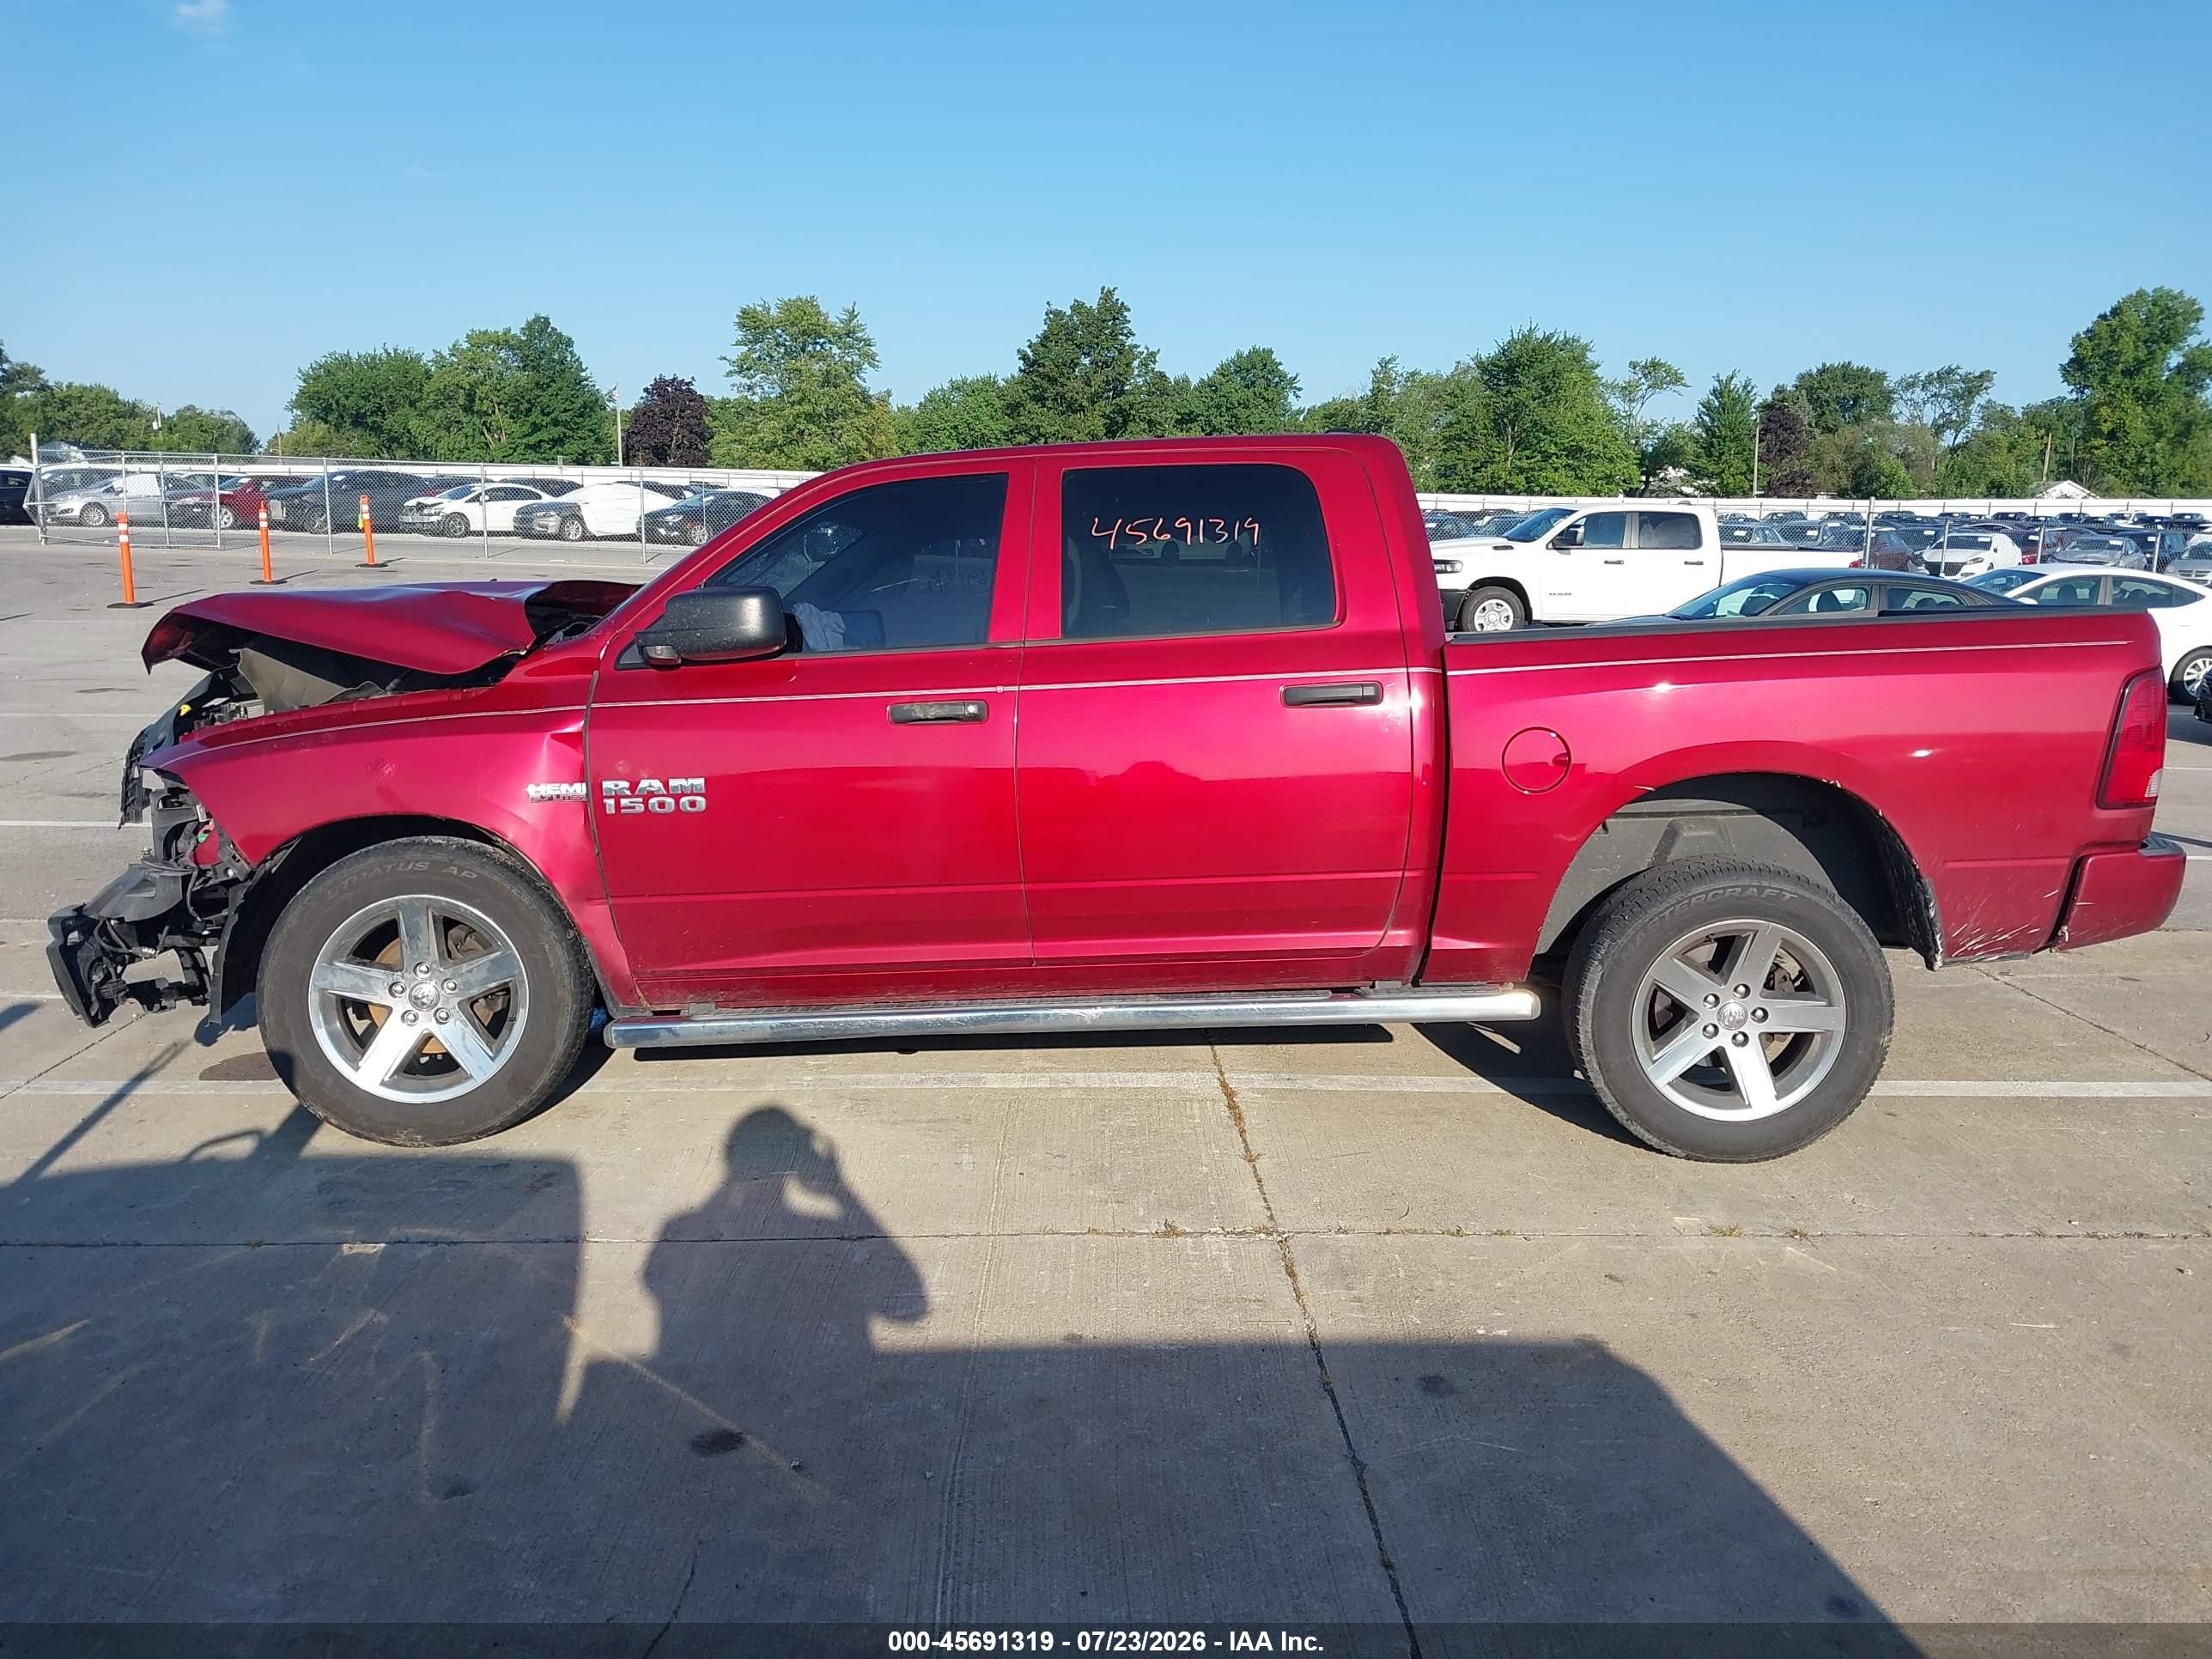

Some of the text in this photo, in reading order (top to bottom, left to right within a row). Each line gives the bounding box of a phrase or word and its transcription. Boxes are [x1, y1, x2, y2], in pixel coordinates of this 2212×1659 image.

[1091, 517, 1260, 550] 45691319
[526, 781, 586, 794] HEMI
[601, 777, 706, 796] RAM
[602, 795, 707, 815] 1500
